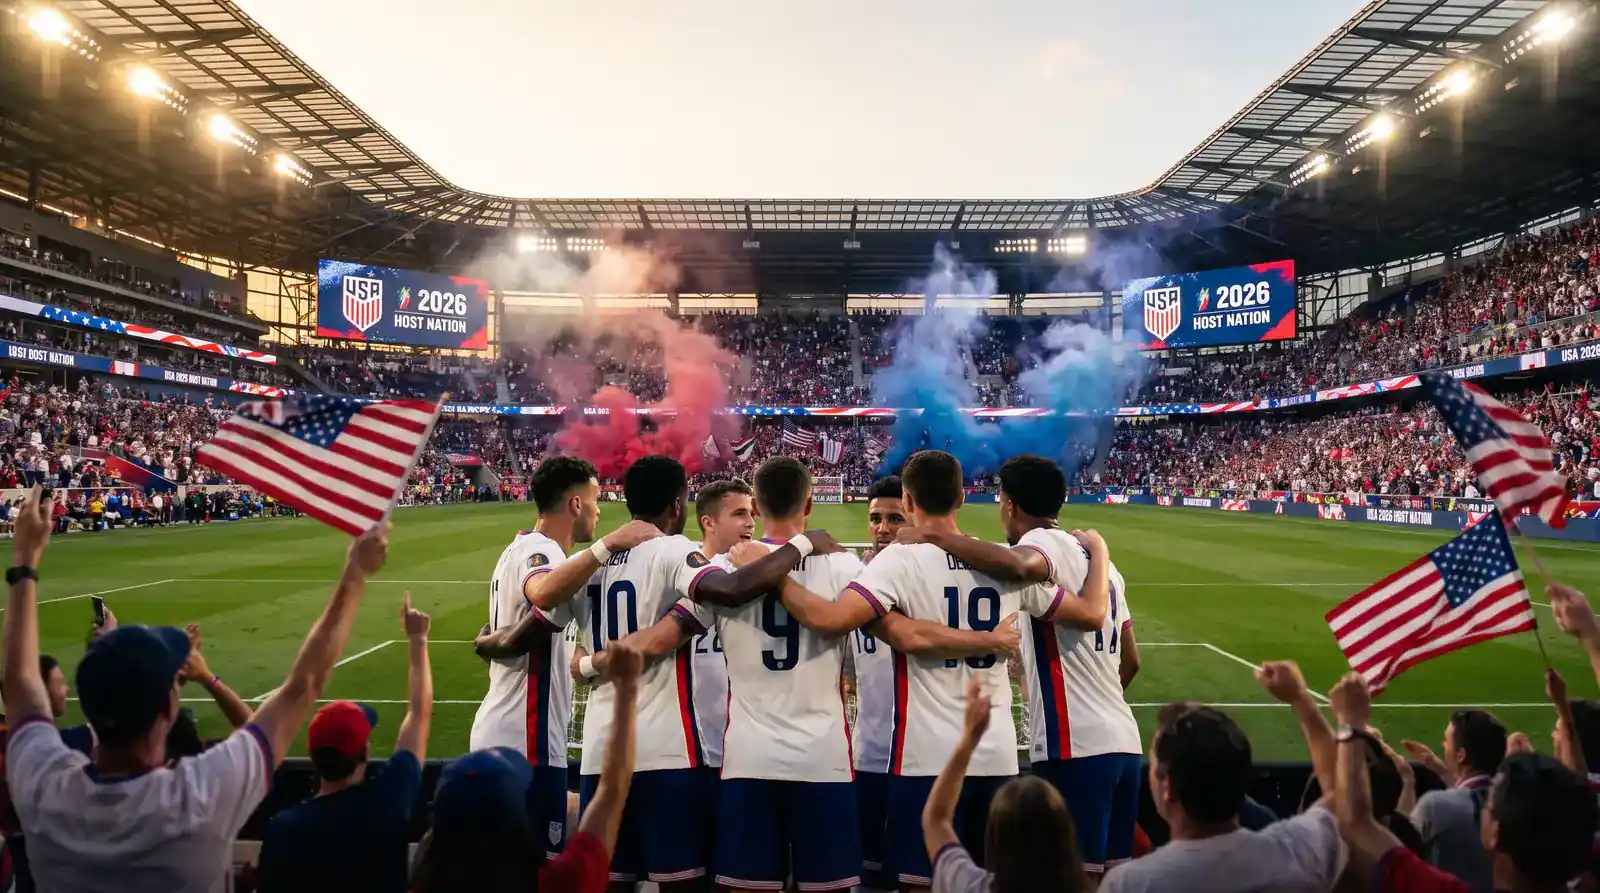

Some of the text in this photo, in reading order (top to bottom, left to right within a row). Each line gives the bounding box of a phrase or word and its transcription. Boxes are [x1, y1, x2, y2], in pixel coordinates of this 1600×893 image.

[346, 278, 380, 301] USA
[1146, 290, 1178, 310] USA
[1216, 281, 1270, 309] 2026
[417, 289, 467, 315] 2026
[394, 314, 467, 334] HOST NATION
[1193, 310, 1270, 330] HOST NATION
[49, 351, 75, 366] NATION
[1561, 348, 1579, 361] USA
[587, 580, 638, 653] 10
[762, 588, 800, 671] 9
